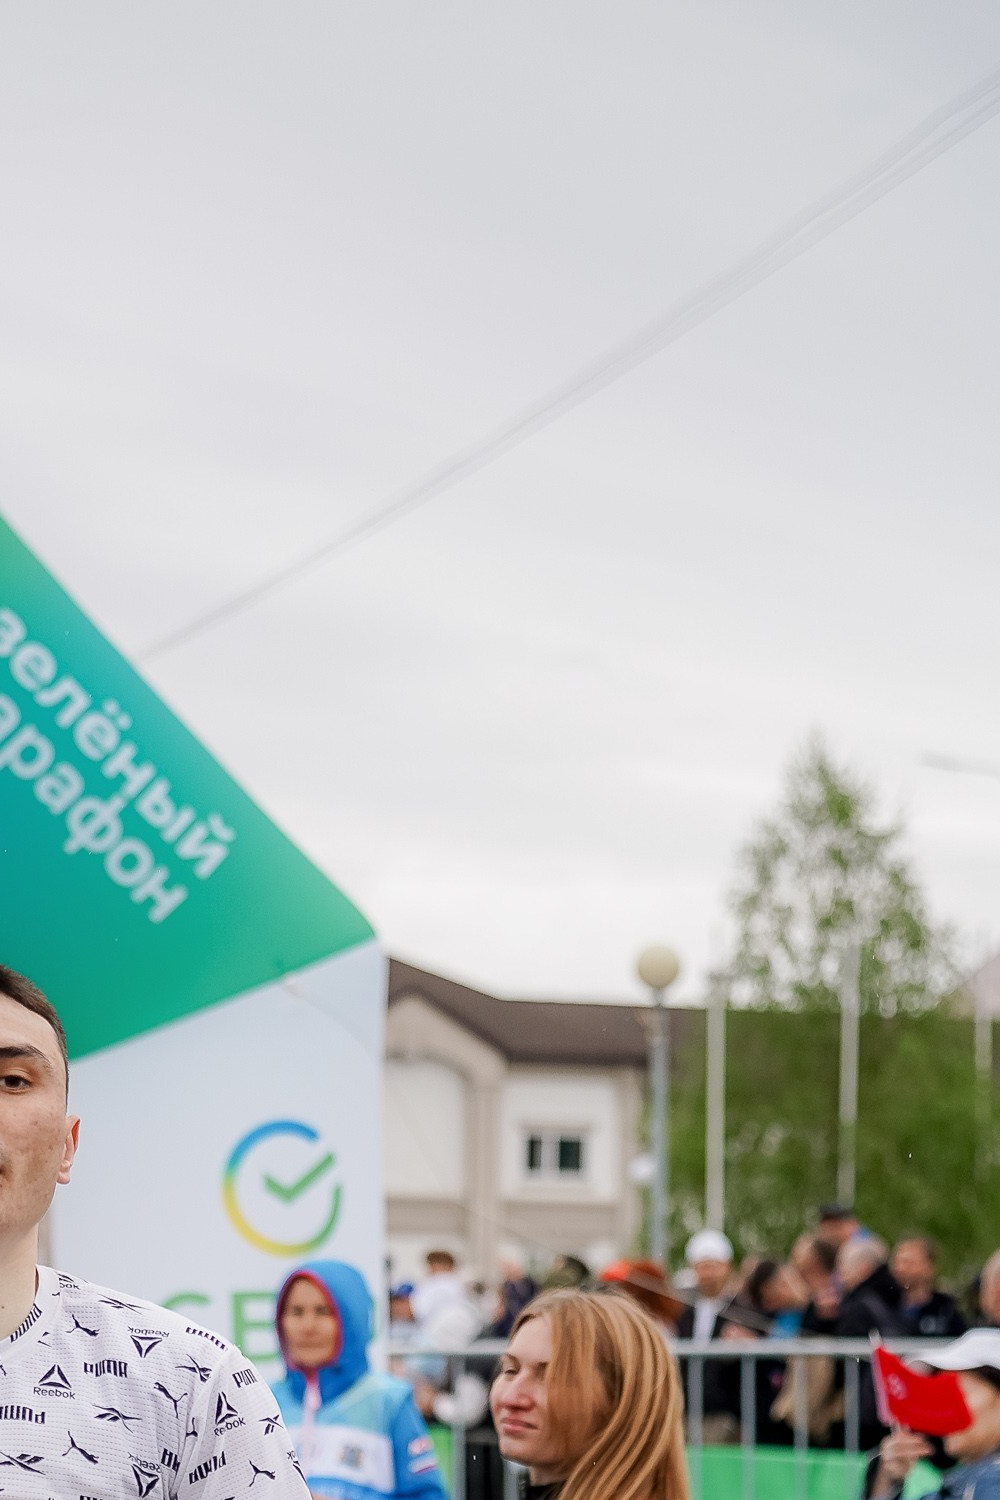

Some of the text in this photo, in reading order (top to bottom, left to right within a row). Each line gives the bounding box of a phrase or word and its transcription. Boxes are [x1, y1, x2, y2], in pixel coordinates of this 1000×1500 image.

[128, 1326, 170, 1338] Reebok
[84, 1360, 128, 1378] PUMA
[33, 1387, 76, 1399] Reebok
